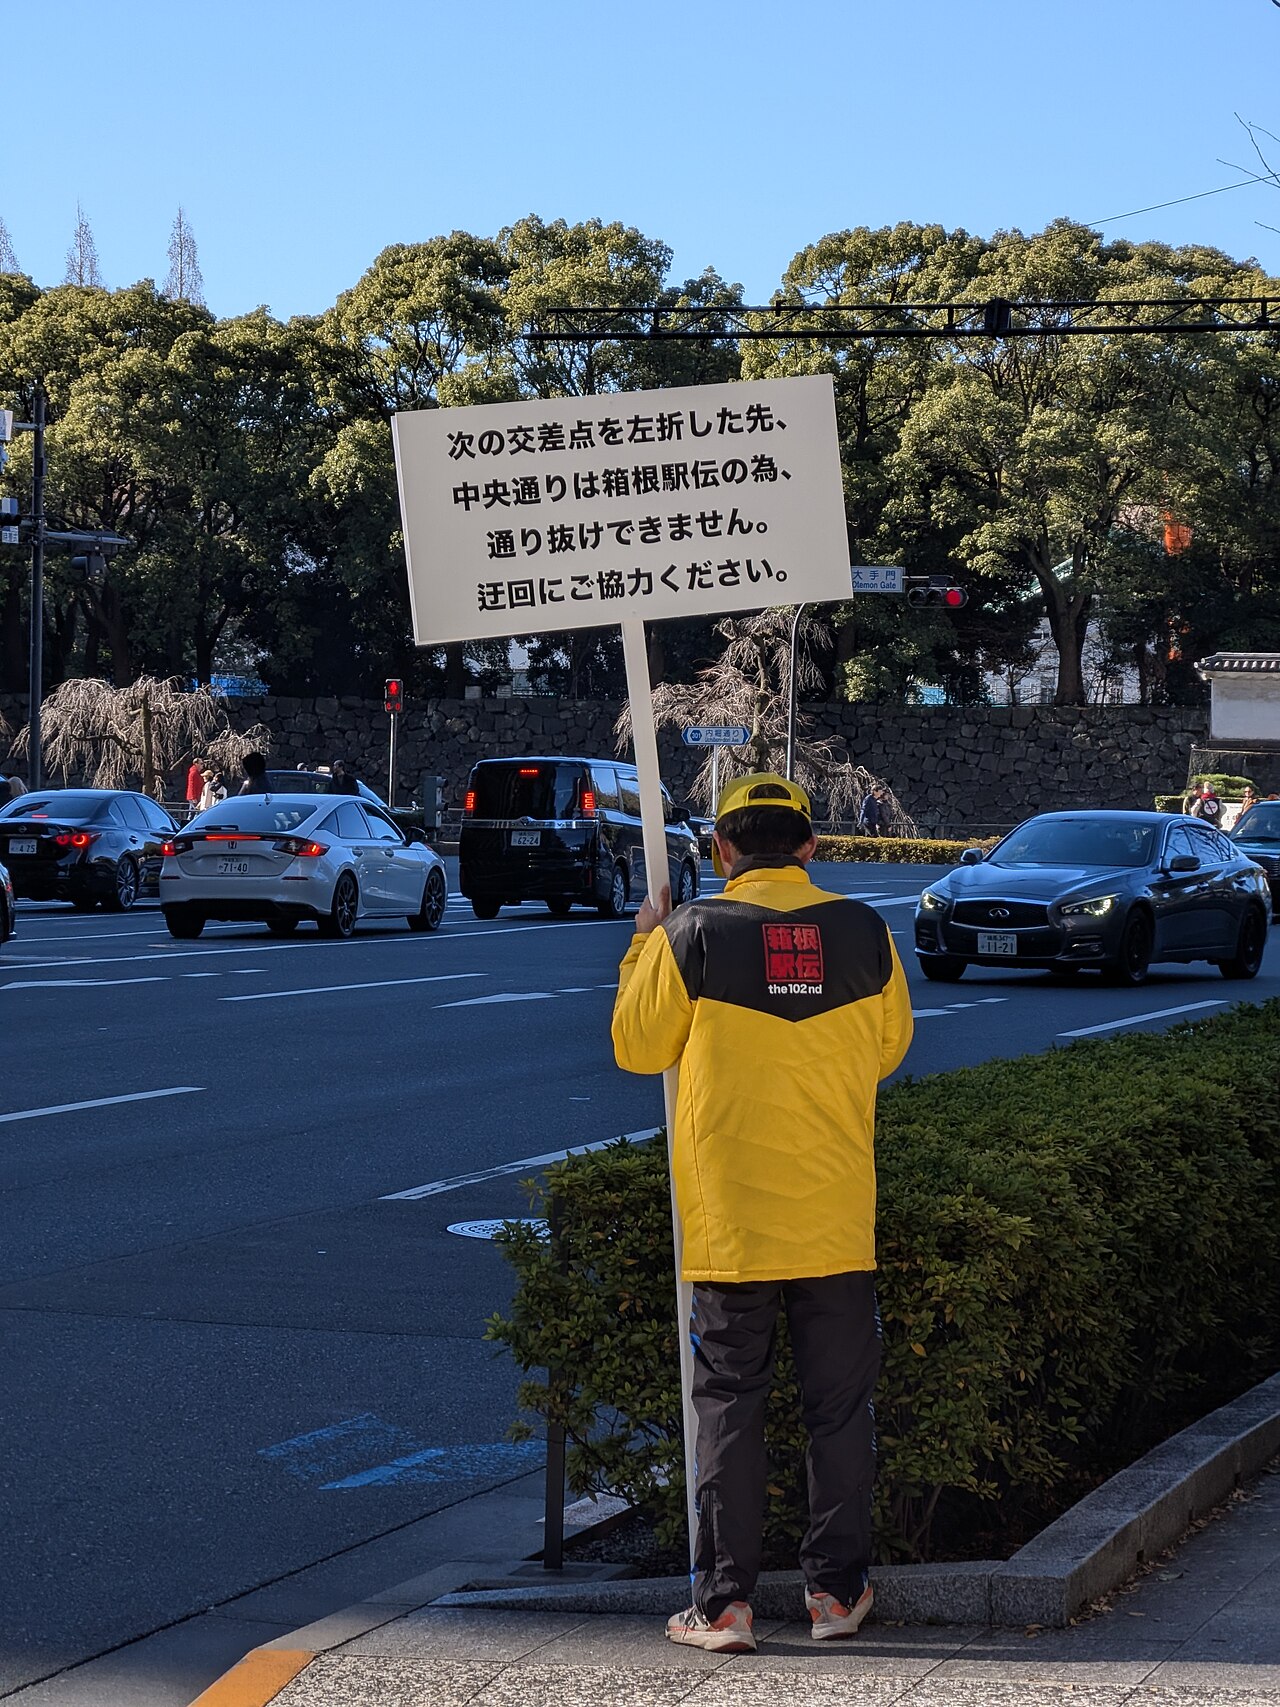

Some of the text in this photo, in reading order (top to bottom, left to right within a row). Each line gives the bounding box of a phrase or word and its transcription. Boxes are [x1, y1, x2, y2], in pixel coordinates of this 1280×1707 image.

[446, 403, 788, 460] 次の交差点を左折した先、
[452, 454, 793, 512] 中央通りは箱根駅伝の為、
[486, 507, 769, 559] 通り抜けできません。
[477, 557, 789, 612] 迂回にご協力ください。
[853, 570, 896, 580] 大手門
[880, 581, 896, 589] Gate
[223, 863, 248, 872] 71-40
[767, 927, 818, 951] 箱根
[987, 942, 1014, 953] 11-21
[770, 953, 819, 978] 駅伝
